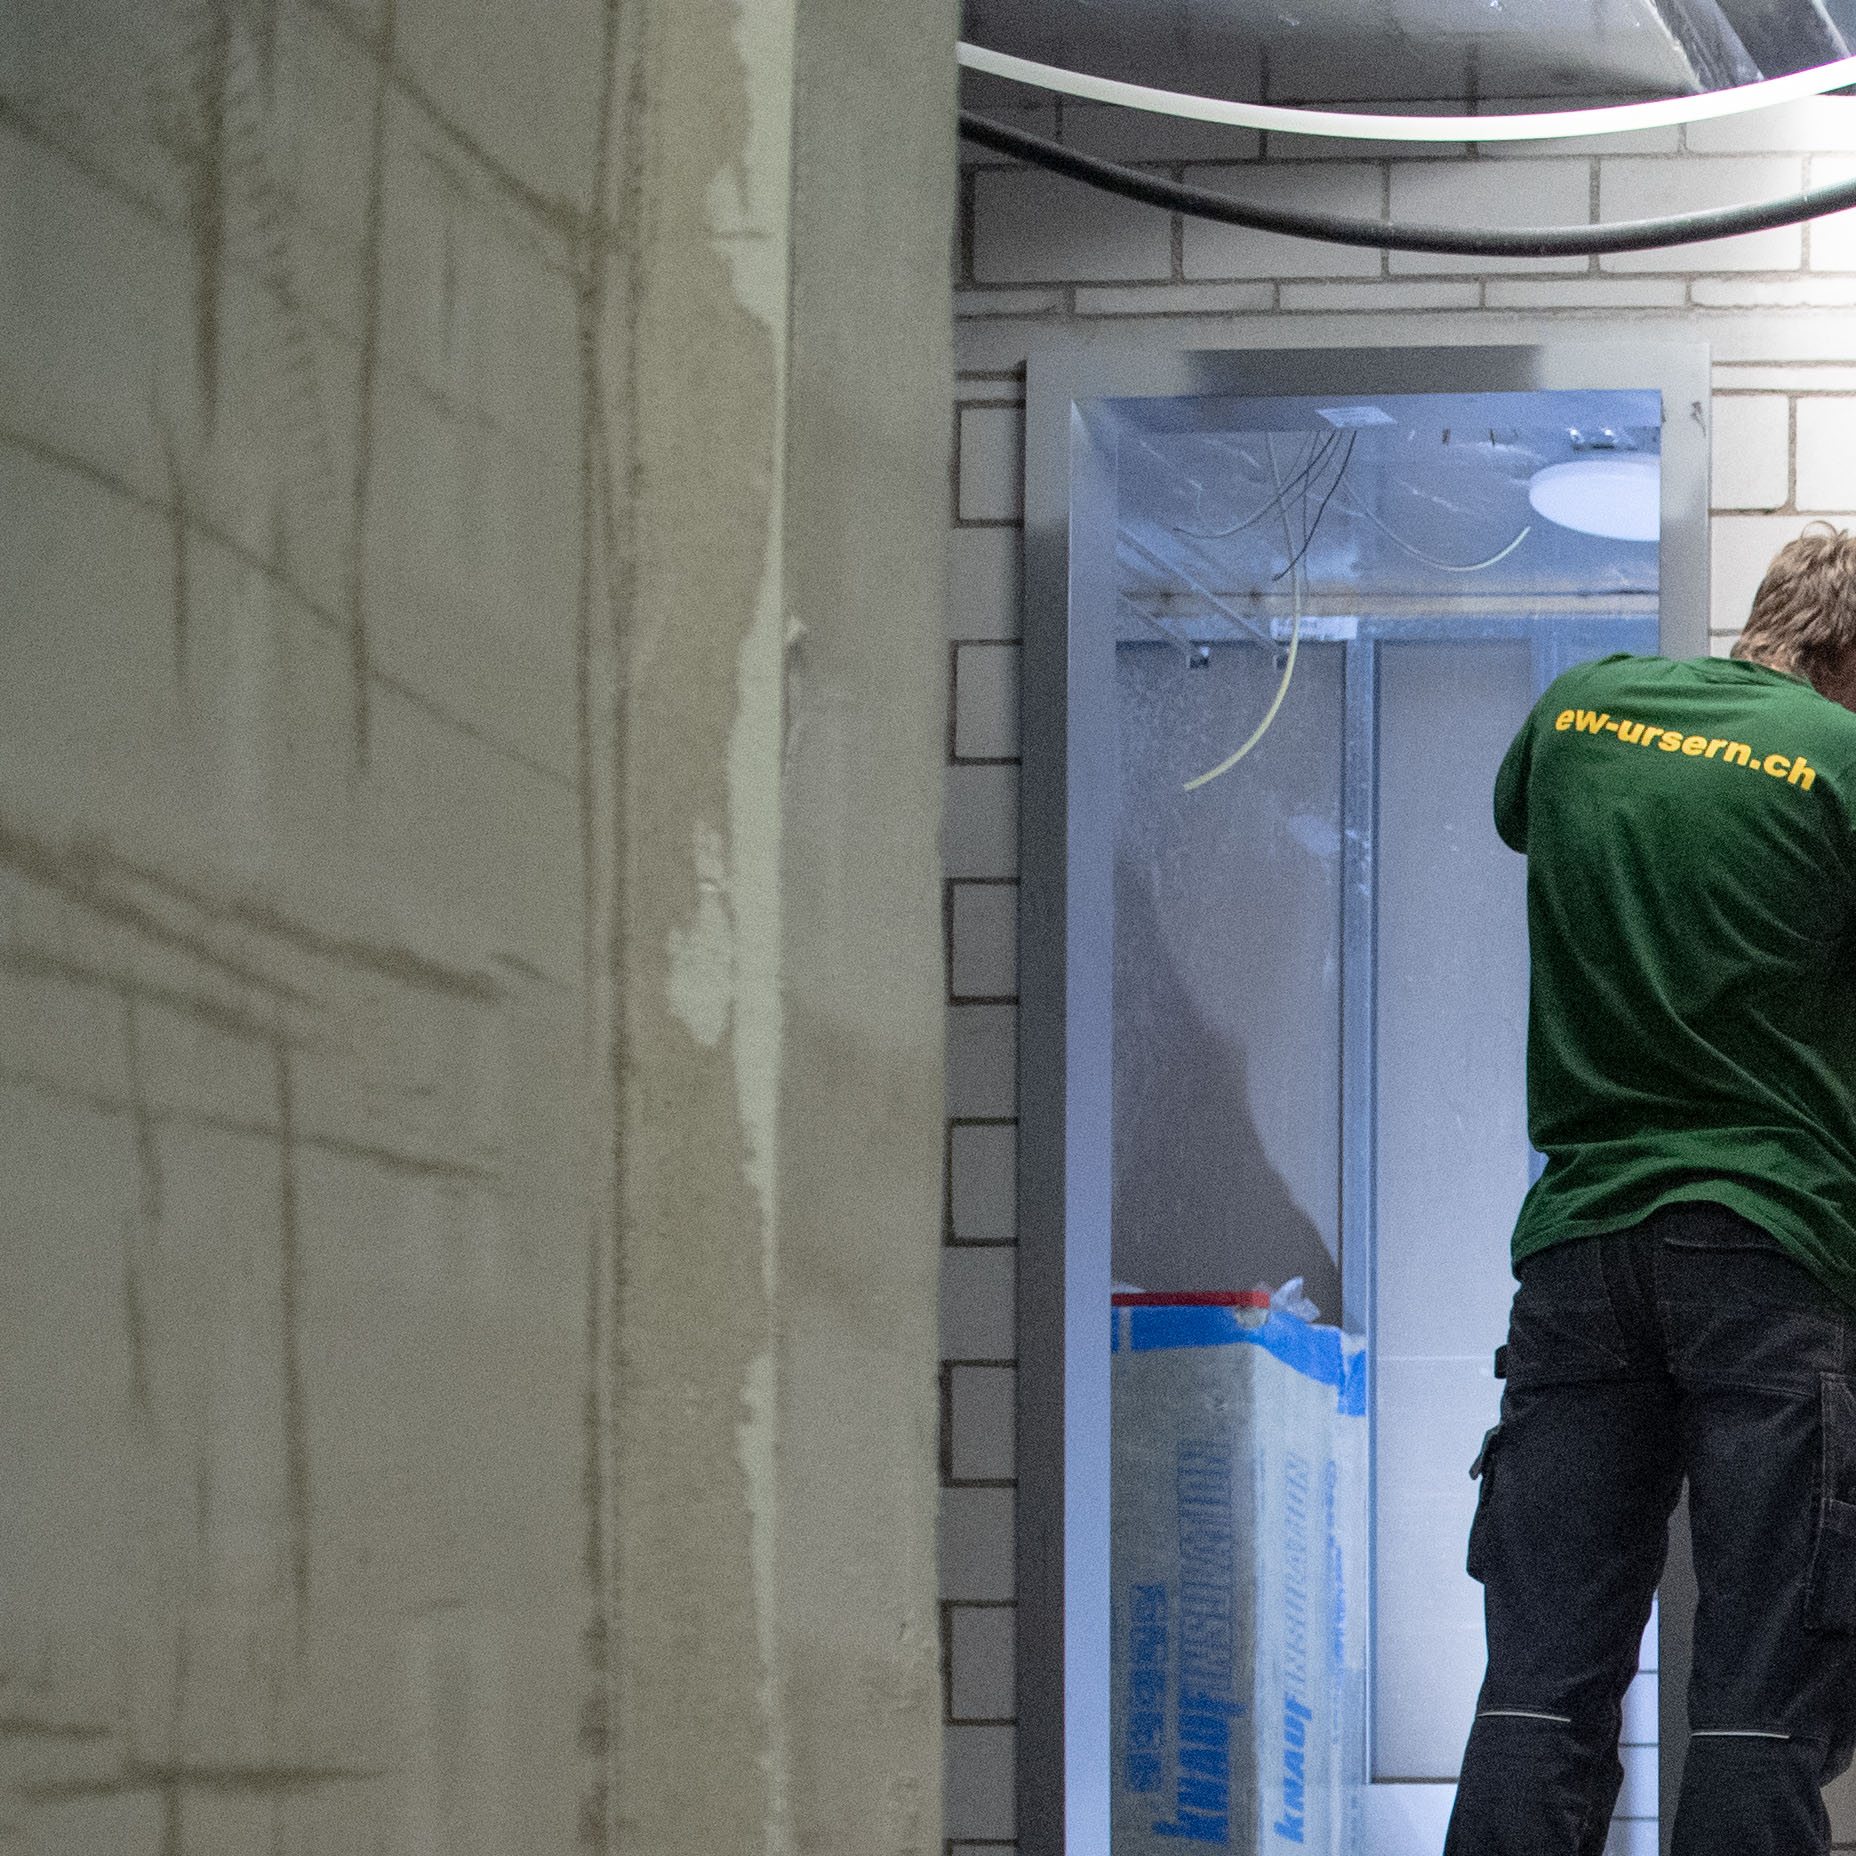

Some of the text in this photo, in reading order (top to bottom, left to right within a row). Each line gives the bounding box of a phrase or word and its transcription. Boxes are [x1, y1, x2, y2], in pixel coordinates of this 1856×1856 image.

[1555, 709, 1817, 790] ew-ursern.ch
[1176, 1438, 1233, 1696] INSULATION
[1282, 1450, 1309, 1696] INSULATION
